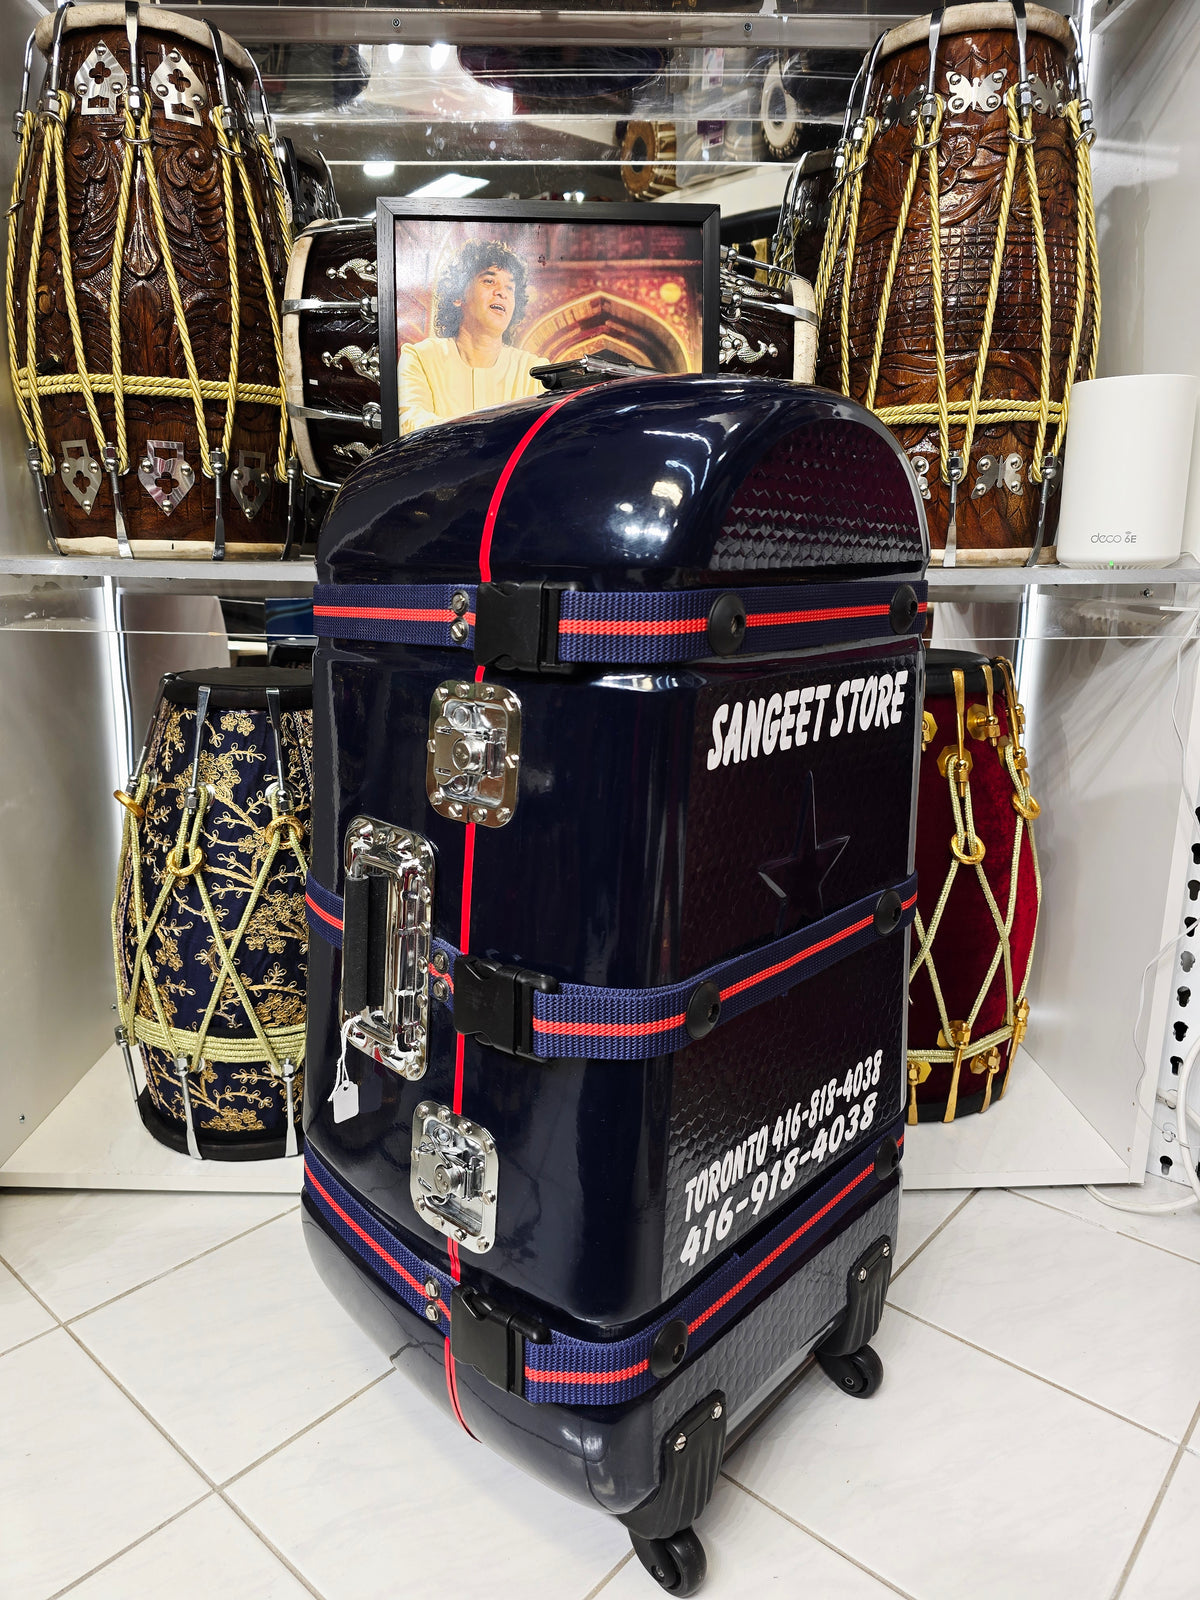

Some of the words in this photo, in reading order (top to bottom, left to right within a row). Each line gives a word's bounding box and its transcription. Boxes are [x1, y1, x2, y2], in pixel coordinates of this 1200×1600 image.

[1090, 533, 1122, 543] deco
[1124, 534, 1137, 543] 6E
[707, 684, 831, 770] SANGEET
[830, 670, 909, 737] STORE
[679, 1091, 878, 1266] 416-918-4038
[684, 1124, 769, 1222] TORONTO
[772, 1049, 883, 1152] 416-818-4038
